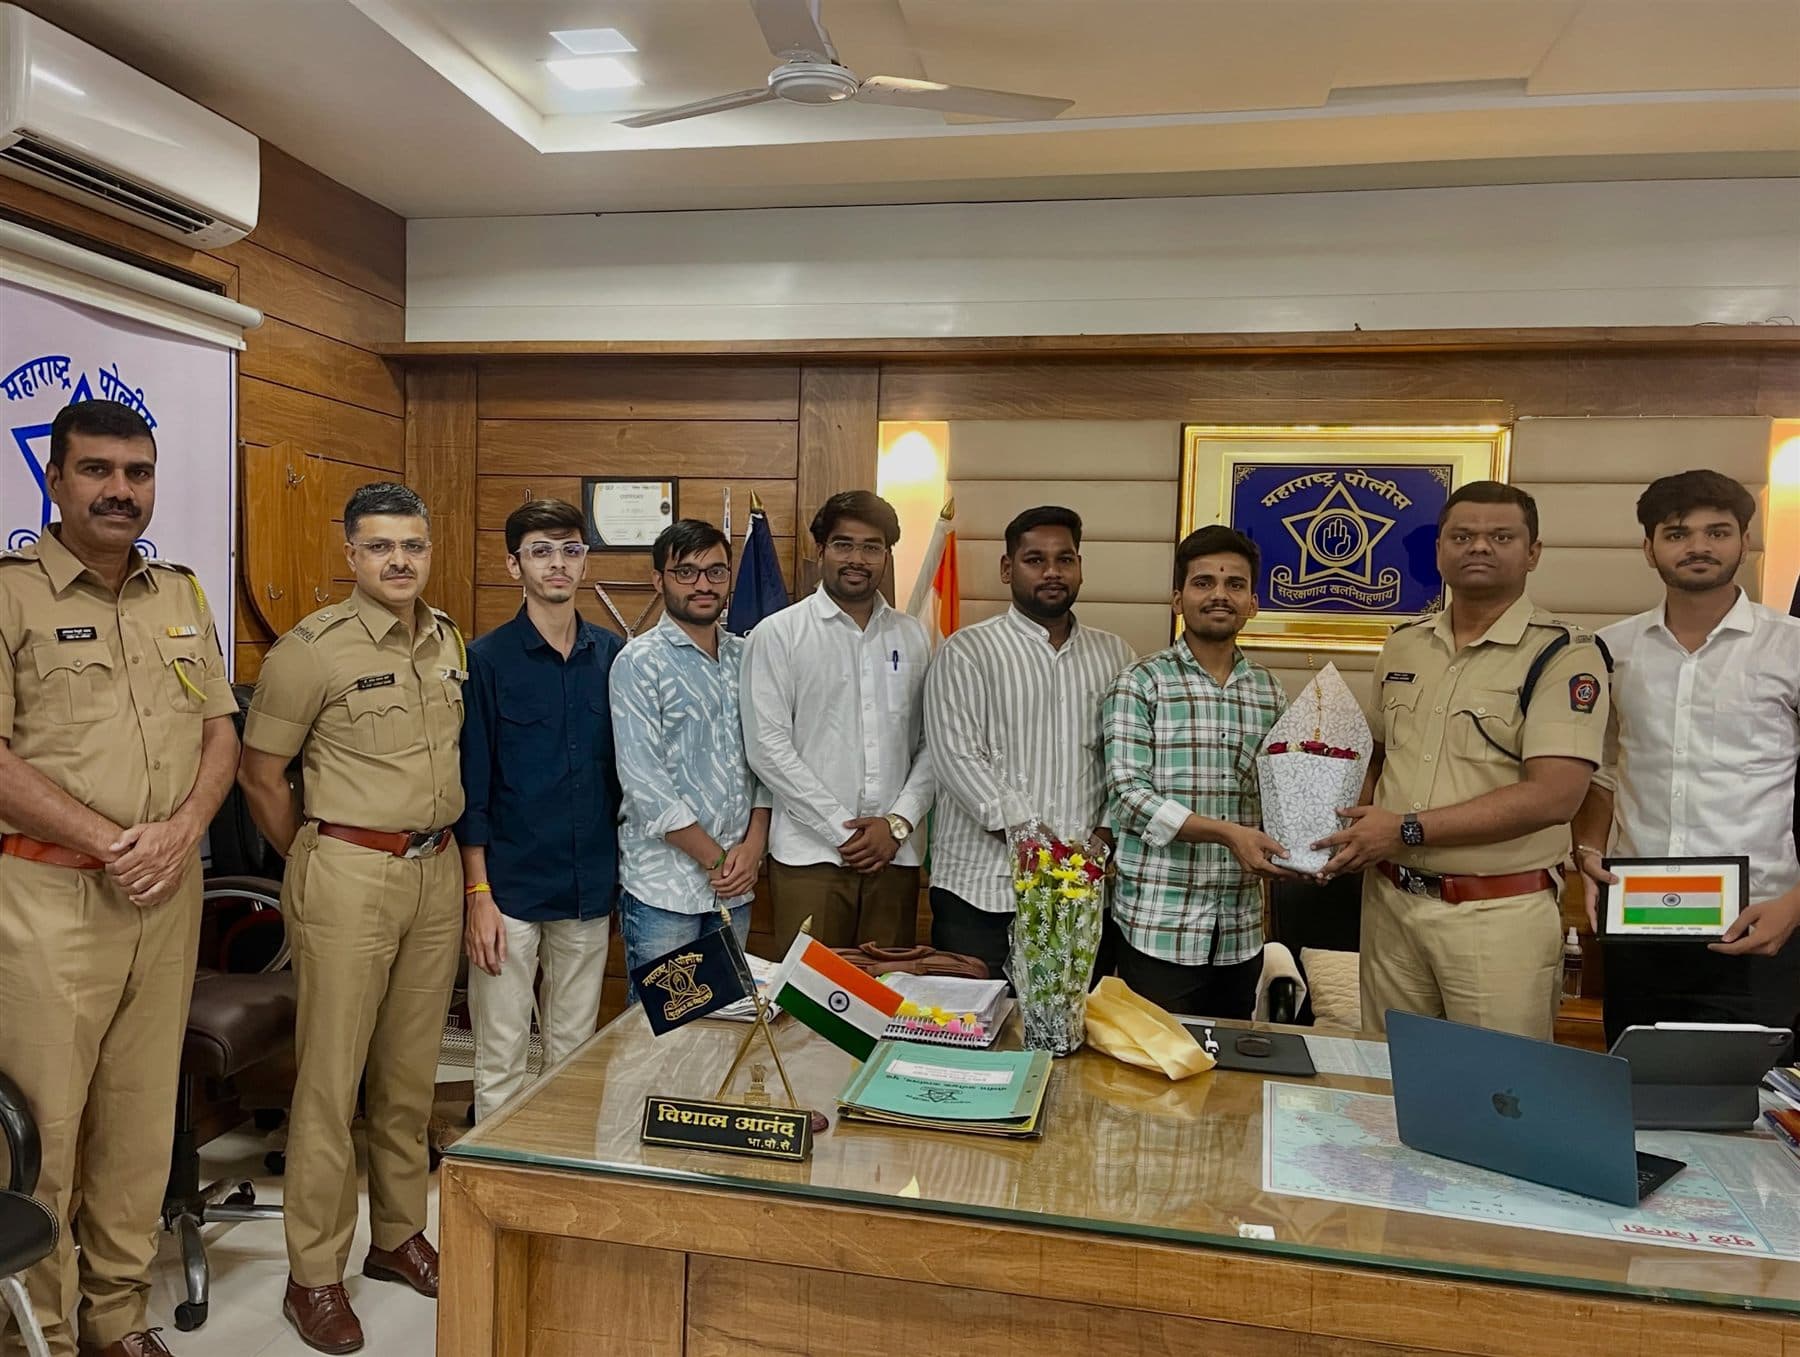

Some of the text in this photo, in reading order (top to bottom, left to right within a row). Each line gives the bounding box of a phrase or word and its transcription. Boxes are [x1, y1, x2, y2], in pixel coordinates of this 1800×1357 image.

[0, 355, 157, 428] महाराष्ट्र पोली
[1260, 469, 1413, 510] महाराष्ट्र पोलीस
[657, 1103, 796, 1138] विशाल आनंद
[747, 1136, 794, 1152] भा.पो.से.
